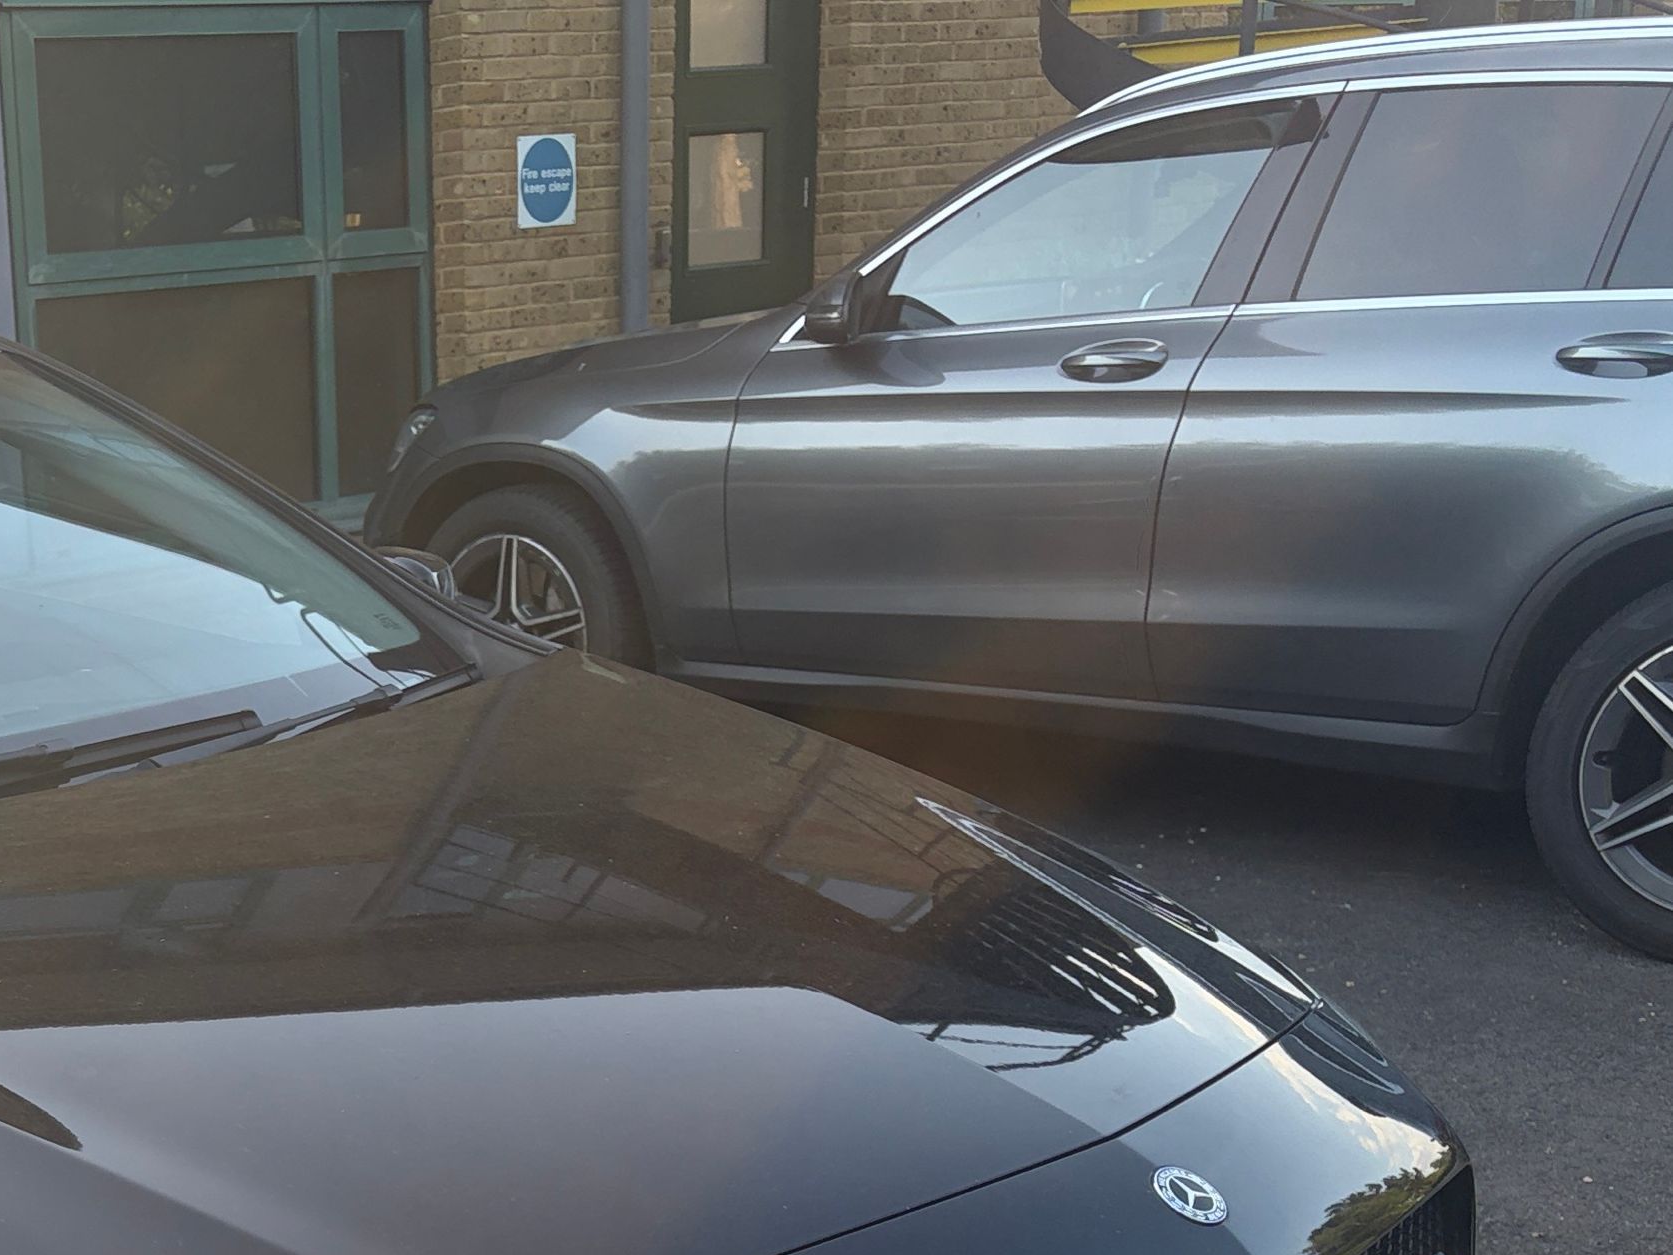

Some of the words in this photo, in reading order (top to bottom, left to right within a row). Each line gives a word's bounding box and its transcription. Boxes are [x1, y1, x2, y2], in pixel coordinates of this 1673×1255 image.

[522, 168, 538, 179] Fire
[541, 168, 571, 179] escape
[524, 182, 546, 194] keep
[549, 181, 569, 192] clear
